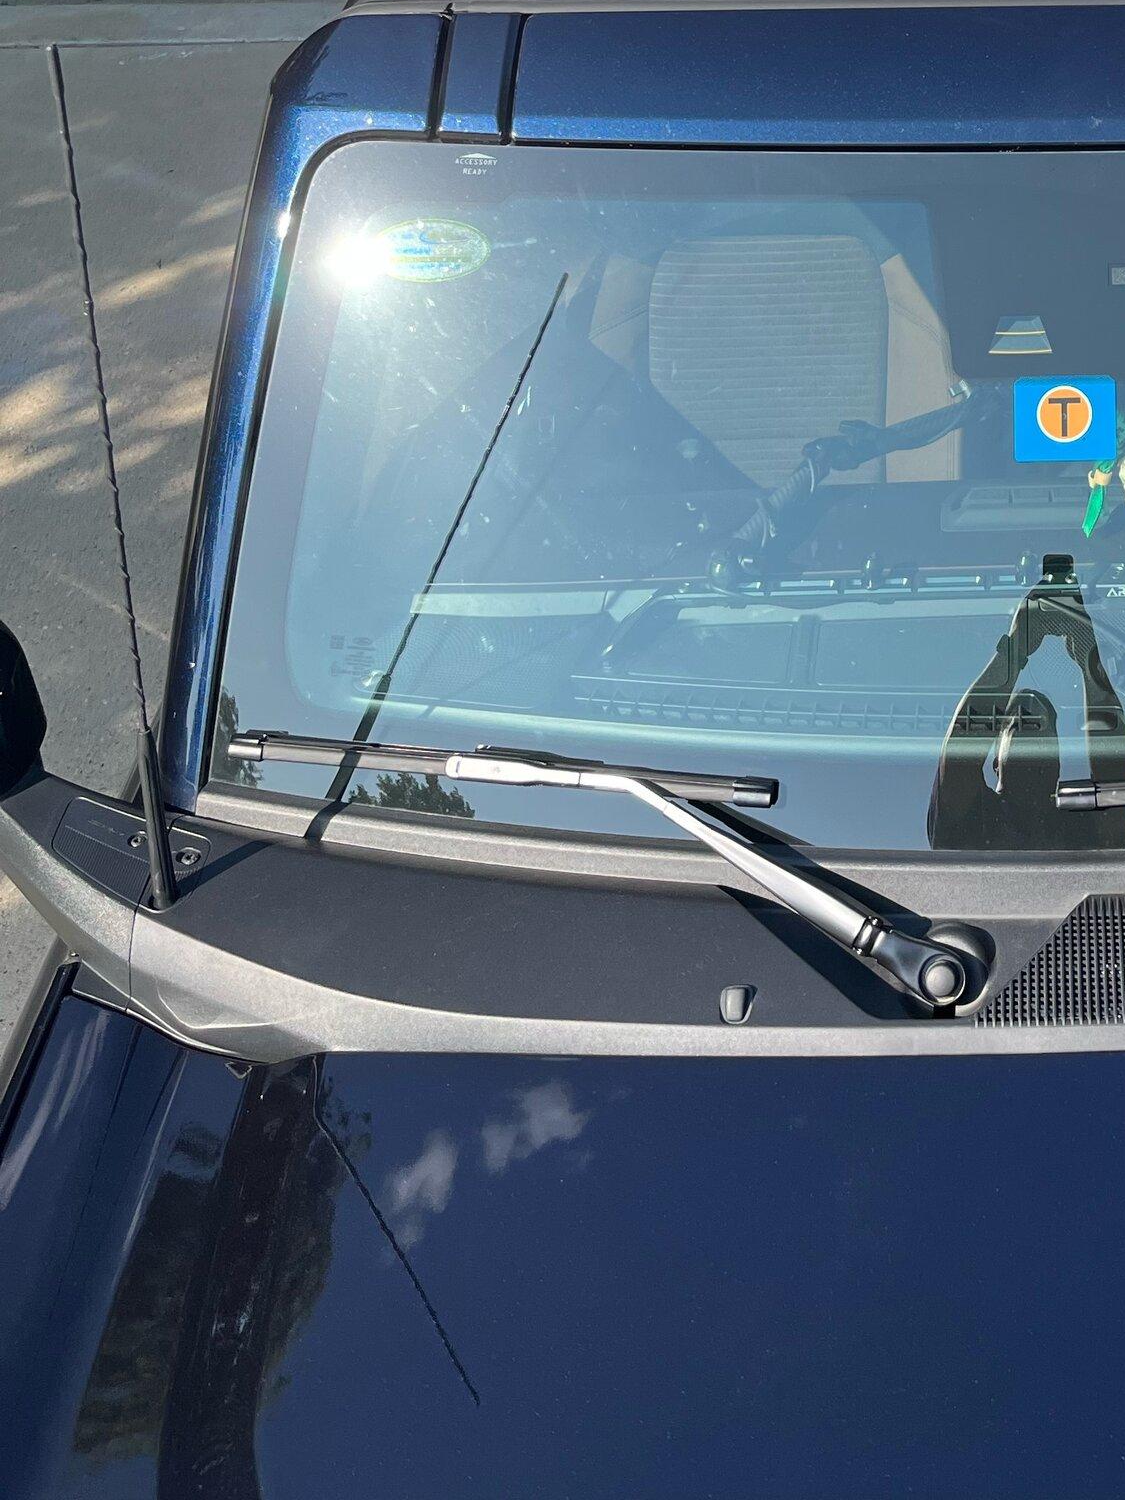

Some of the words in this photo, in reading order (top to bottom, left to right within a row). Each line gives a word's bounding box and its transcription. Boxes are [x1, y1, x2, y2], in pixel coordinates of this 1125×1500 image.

[455, 158, 498, 166] ACCESSORY
[462, 167, 488, 175] READY
[1048, 397, 1081, 437] T
